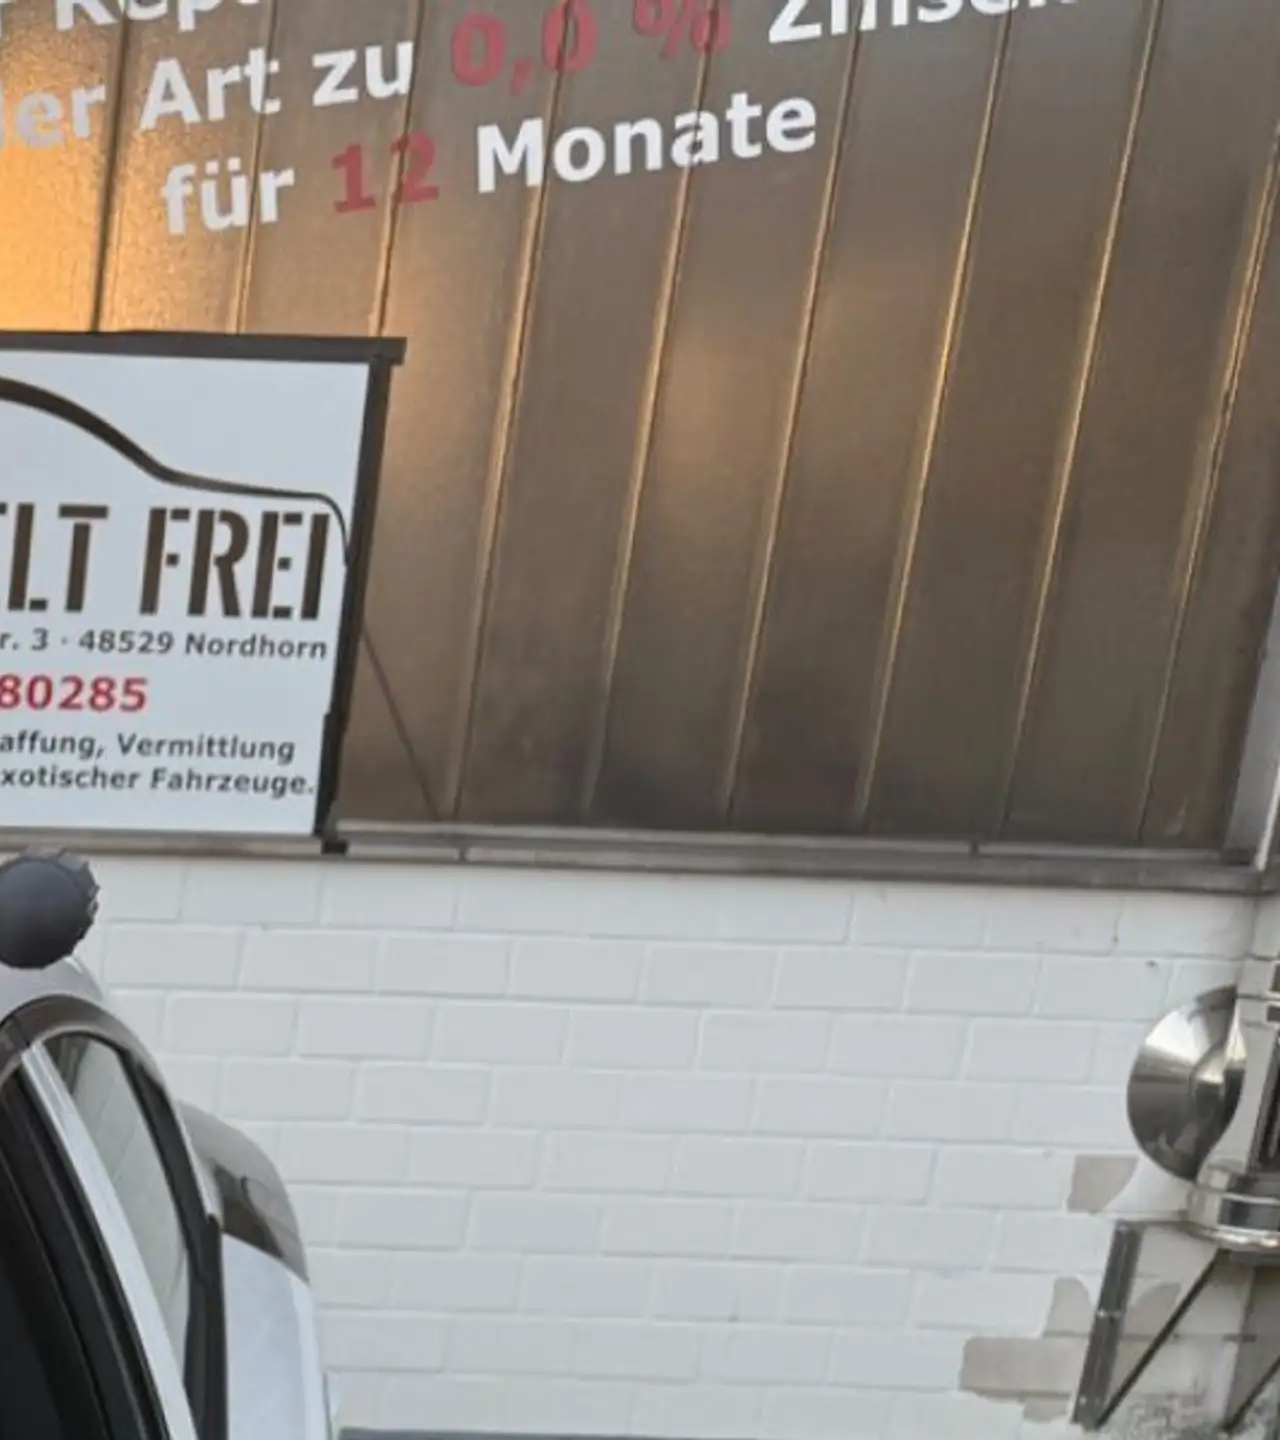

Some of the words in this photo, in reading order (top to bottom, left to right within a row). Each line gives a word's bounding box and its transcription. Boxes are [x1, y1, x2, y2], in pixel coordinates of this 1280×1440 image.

[140, 47, 281, 131] Art
[312, 42, 415, 107] zu
[450, 0, 598, 95] 0,0
[161, 158, 295, 236] für
[331, 130, 439, 214] 12
[476, 92, 817, 193] Monate
[139, 506, 331, 621] FREI
[31, 627, 49, 651] 3
[77, 630, 174, 655] 48529
[184, 631, 328, 660] Nordhorn
[116, 732, 297, 766] Vermittlung
[149, 767, 317, 799] Fahrzeuge.
